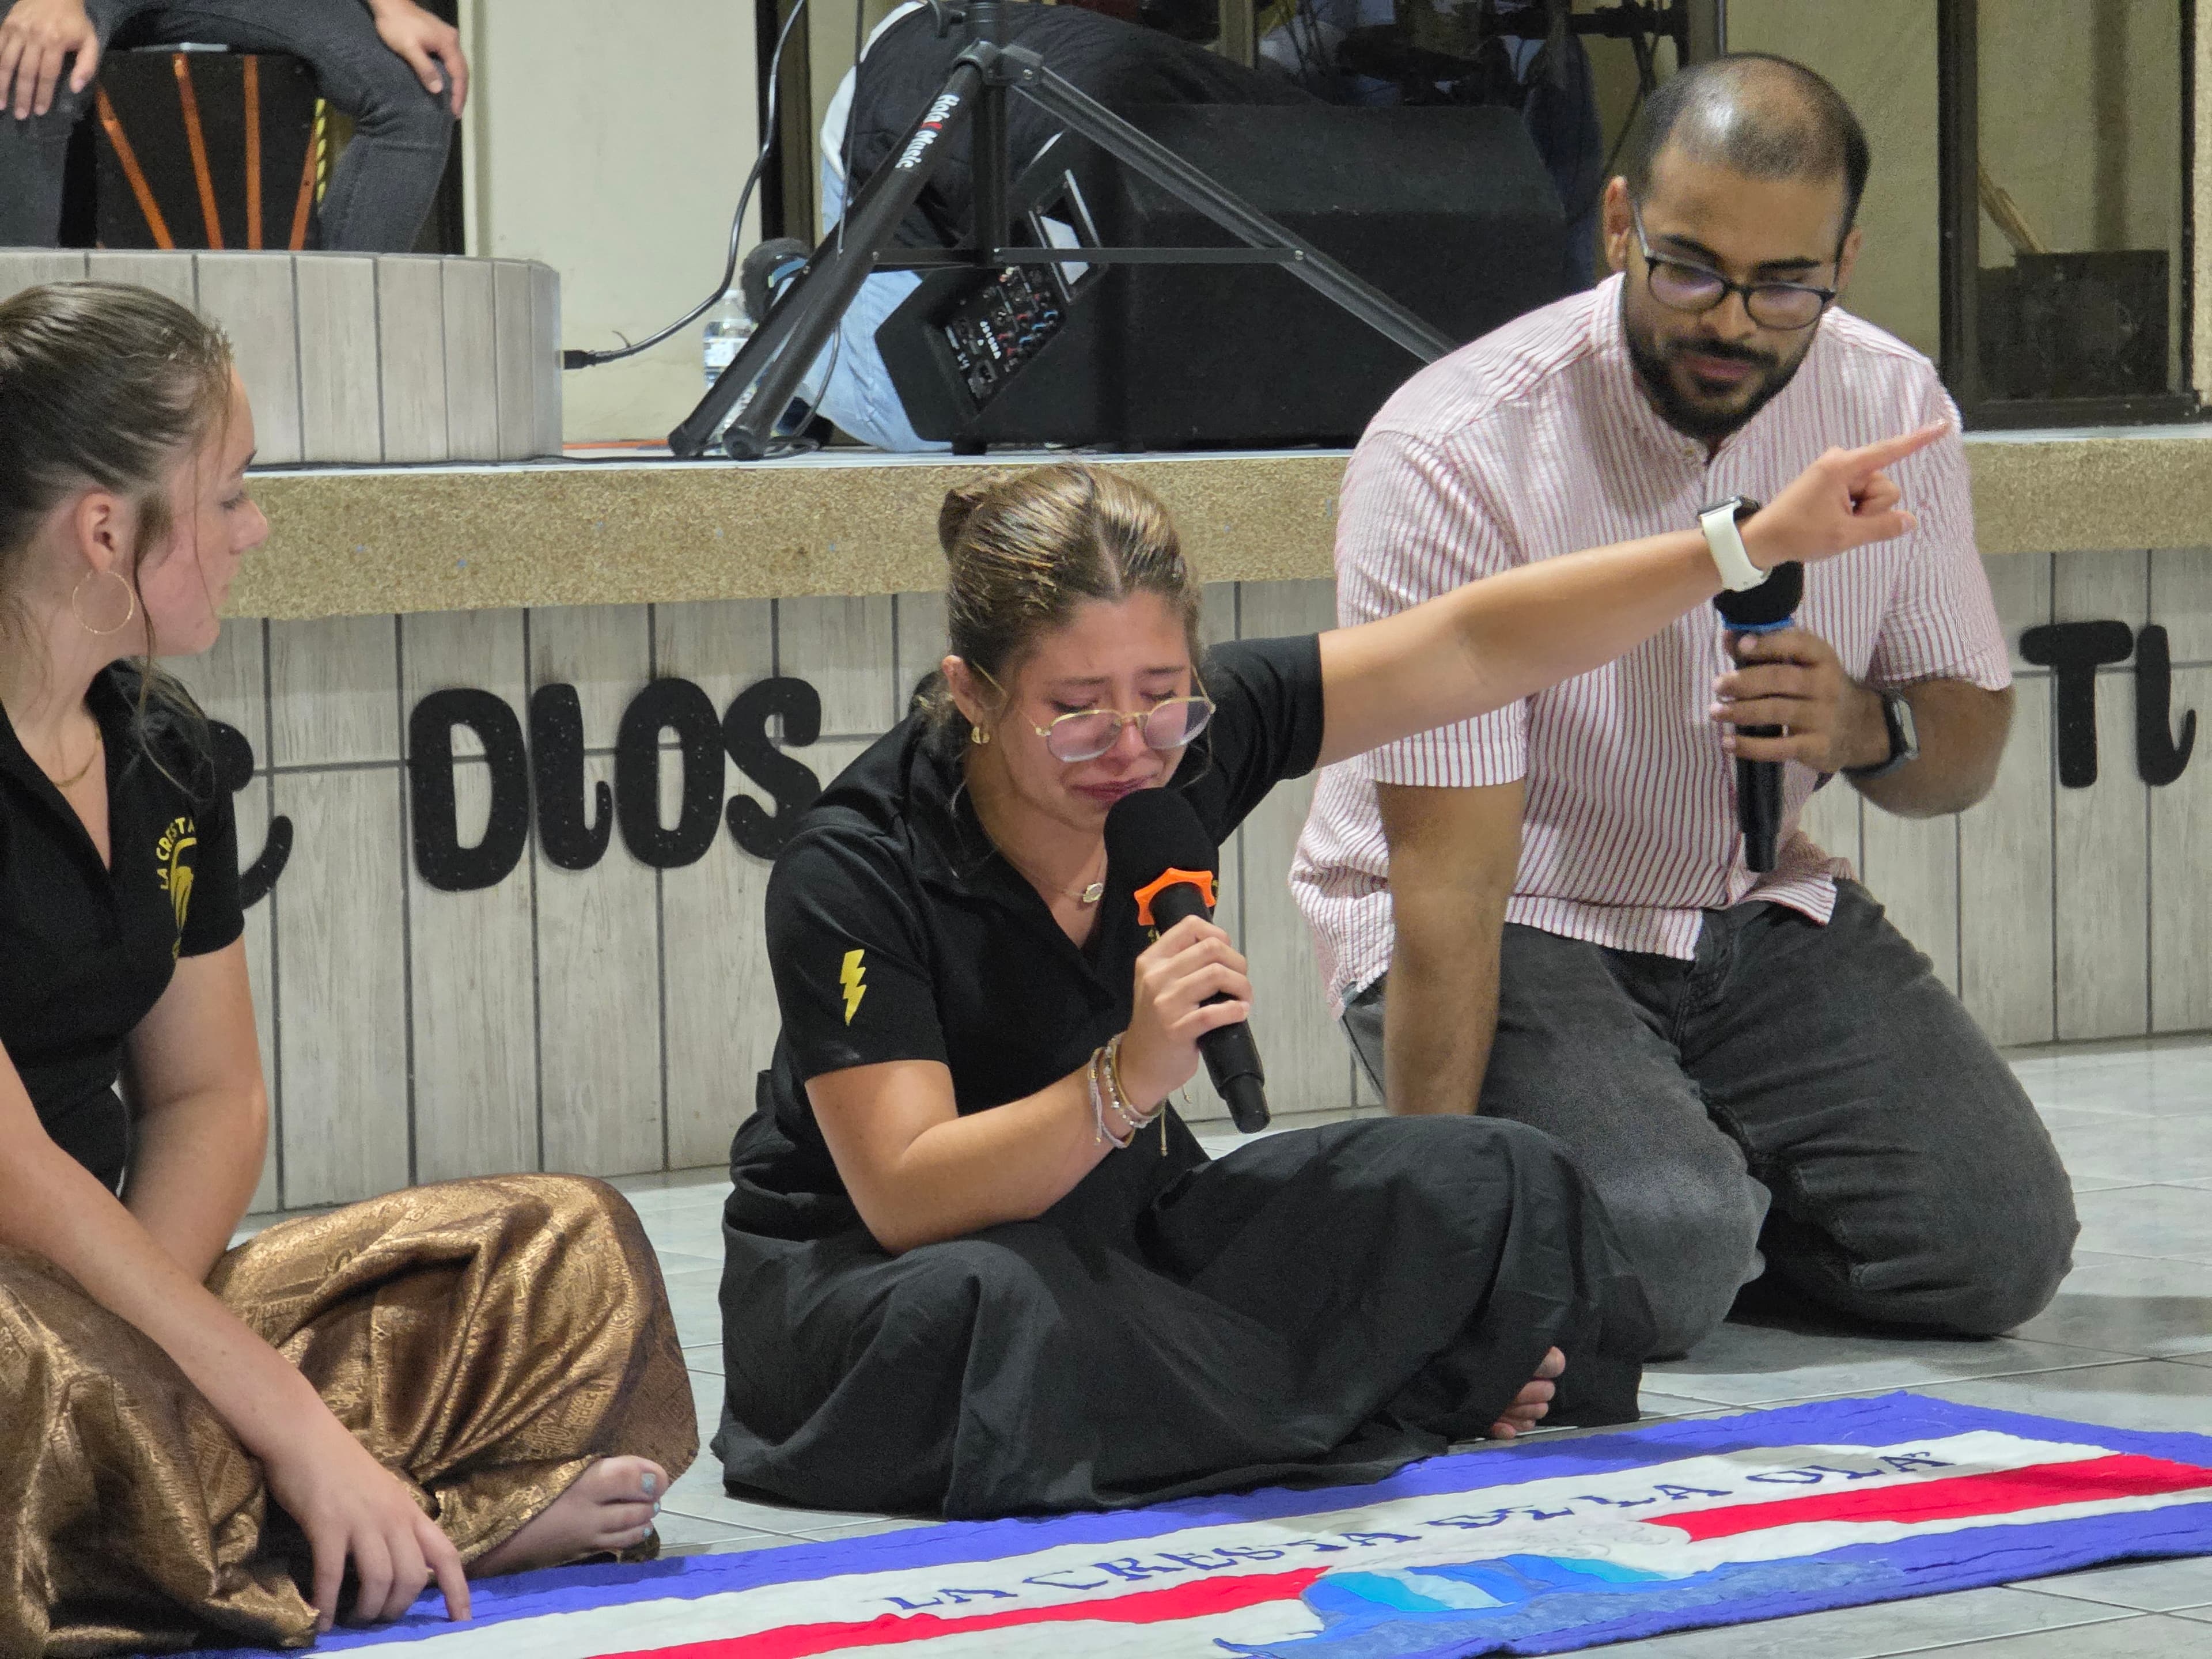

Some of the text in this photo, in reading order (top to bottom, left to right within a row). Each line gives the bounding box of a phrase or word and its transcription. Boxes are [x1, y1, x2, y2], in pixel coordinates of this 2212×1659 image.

[895, 130, 938, 168] Music
[157, 868, 169, 889] LA
[884, 1588, 1018, 1609] LA
[1022, 1532, 1423, 1590] CRESTA
[1571, 1484, 1733, 1508] LA
